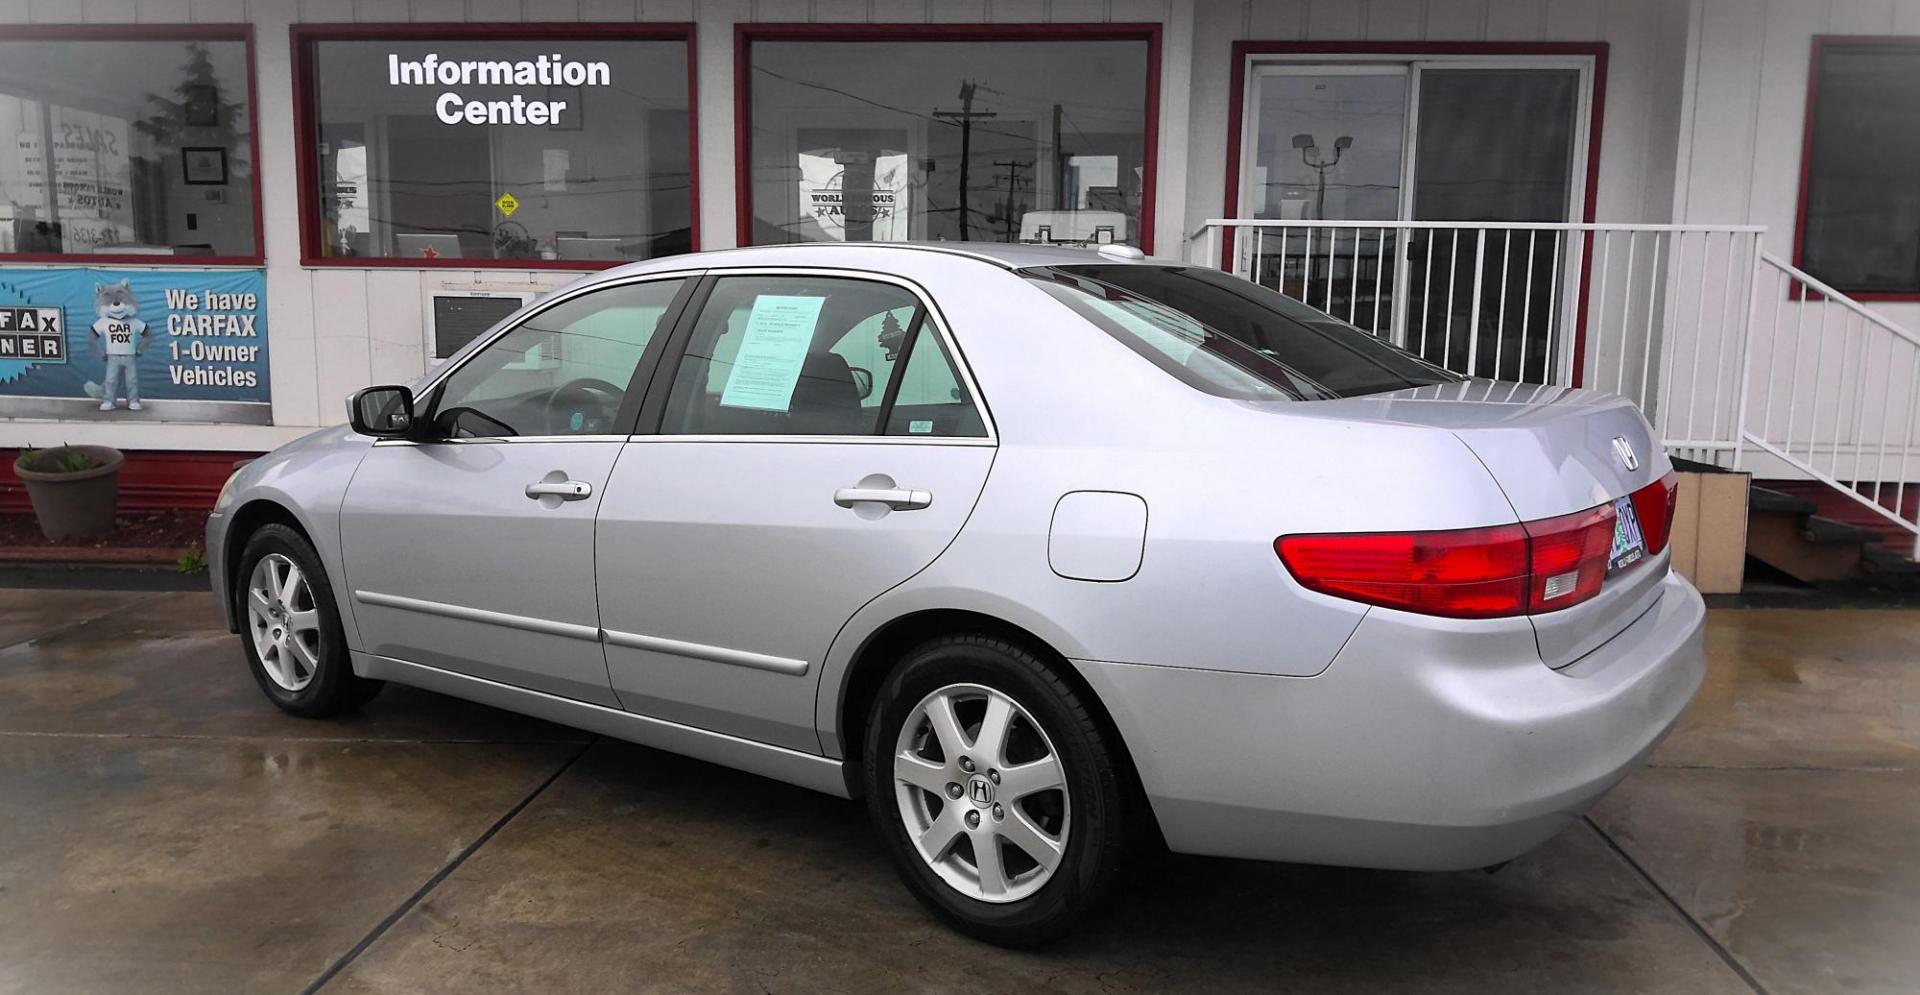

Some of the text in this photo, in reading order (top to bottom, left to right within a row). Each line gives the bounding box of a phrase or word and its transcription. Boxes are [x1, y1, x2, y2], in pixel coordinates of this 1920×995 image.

[389, 54, 610, 85] Information
[436, 92, 567, 125] Center
[811, 194, 846, 203] WORL
[829, 205, 879, 216] AUS
[166, 289, 257, 311] We have
[0, 311, 56, 332] FAX
[108, 323, 131, 333] CAR
[167, 315, 257, 337] CARFAX
[1, 338, 58, 355] NER
[110, 333, 131, 344] FOX
[169, 341, 259, 362] 1-Owner
[169, 365, 258, 387] Vehicles
